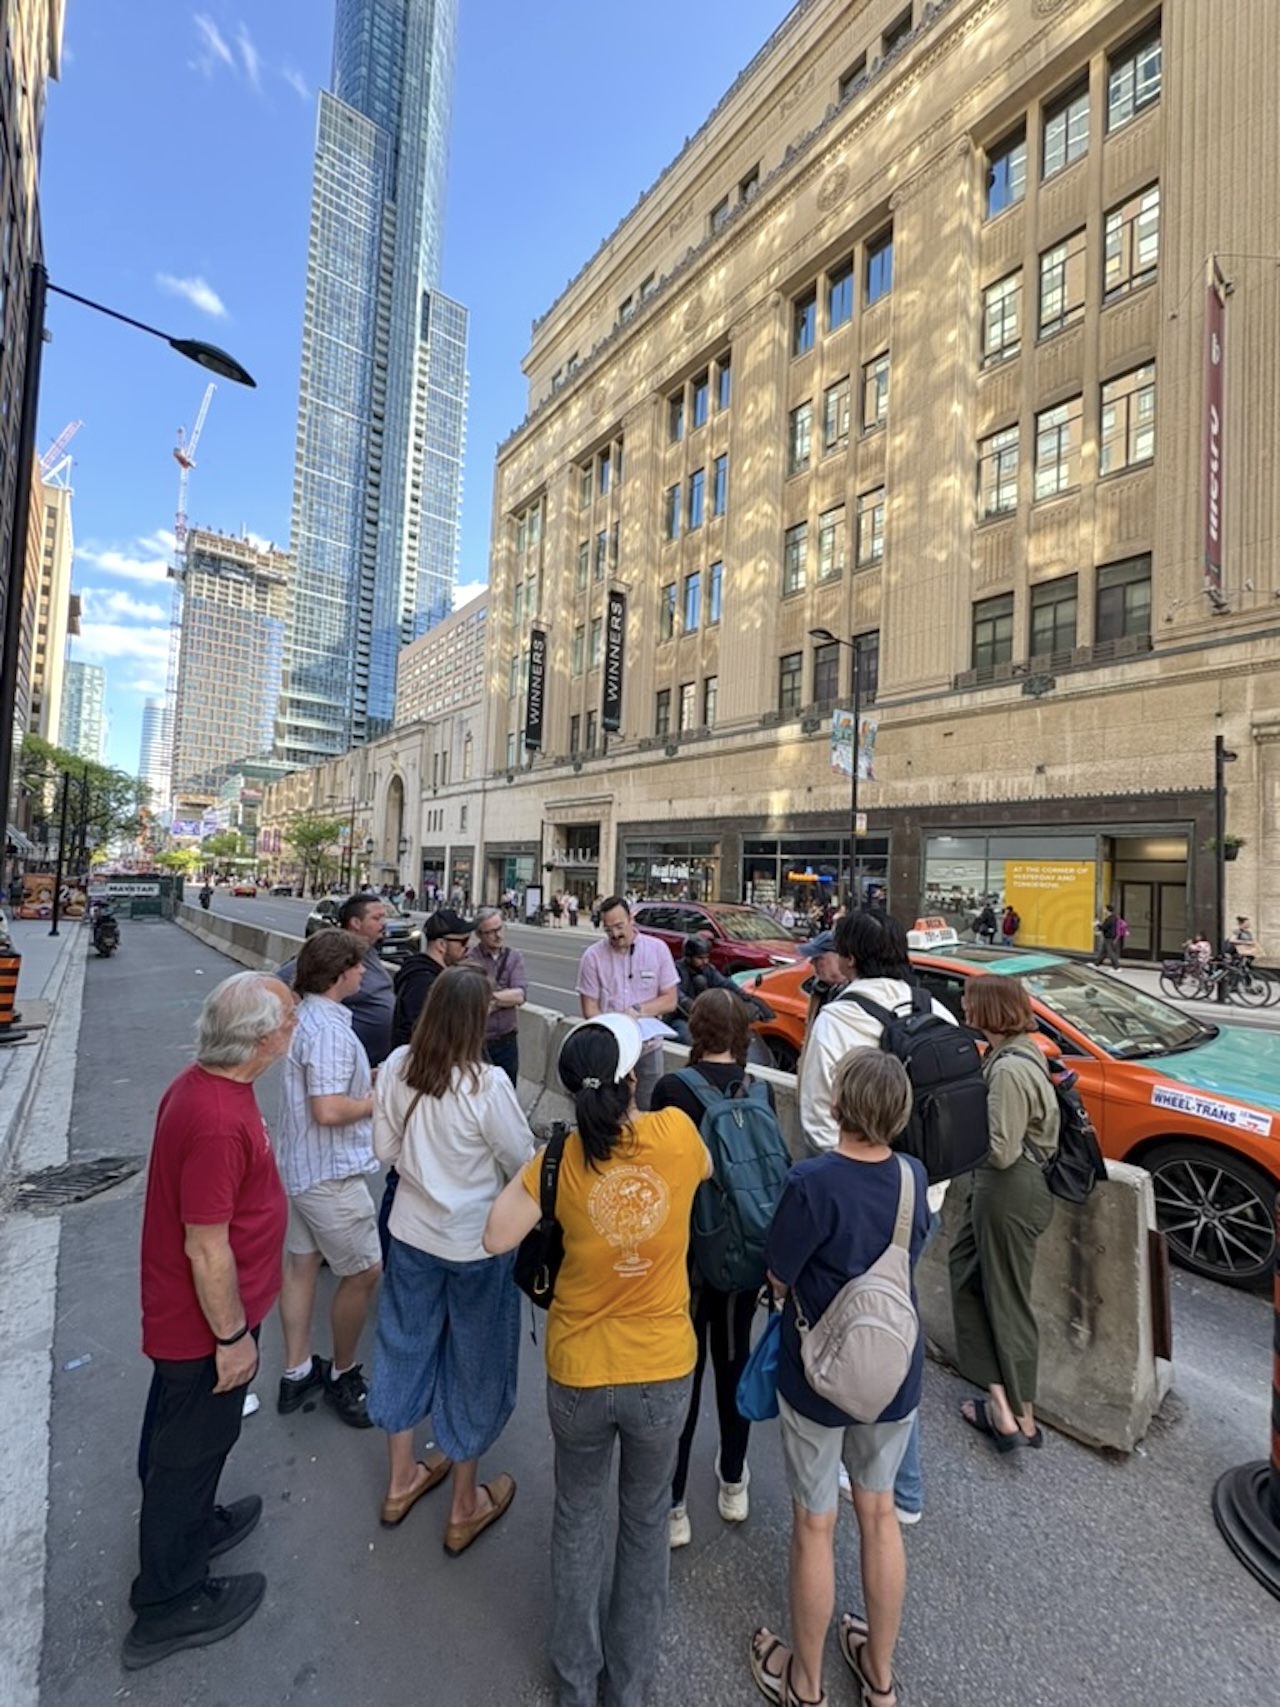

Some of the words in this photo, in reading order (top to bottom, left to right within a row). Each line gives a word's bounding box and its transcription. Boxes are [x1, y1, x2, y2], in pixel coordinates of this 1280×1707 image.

[1210, 404, 1219, 542] metro
[529, 639, 545, 725] WINNERS
[607, 602, 623, 701] WINNERS
[1154, 1093, 1237, 1123] WHEEL-TRANS
